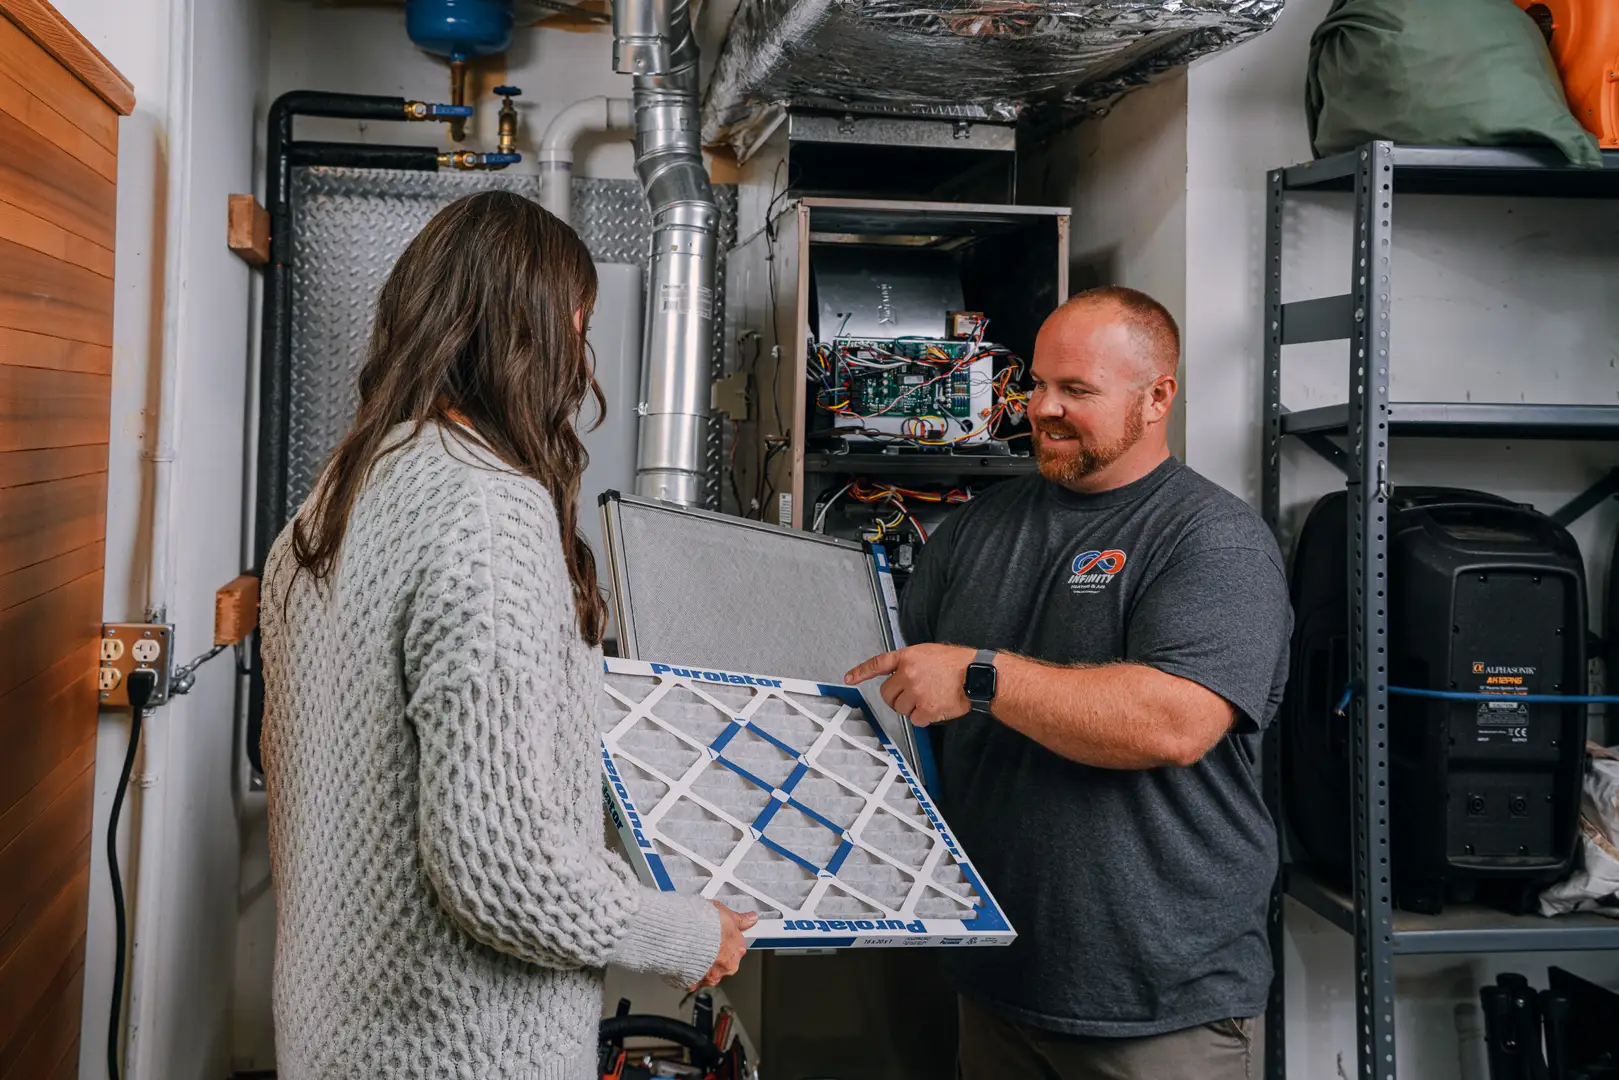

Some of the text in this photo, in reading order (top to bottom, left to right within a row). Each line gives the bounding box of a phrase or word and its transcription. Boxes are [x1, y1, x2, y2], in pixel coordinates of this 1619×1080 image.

[1068, 573, 1115, 584] INFINITY
[650, 662, 783, 689] Purolator
[887, 748, 963, 858] Purolator
[783, 919, 928, 933] Purolator
